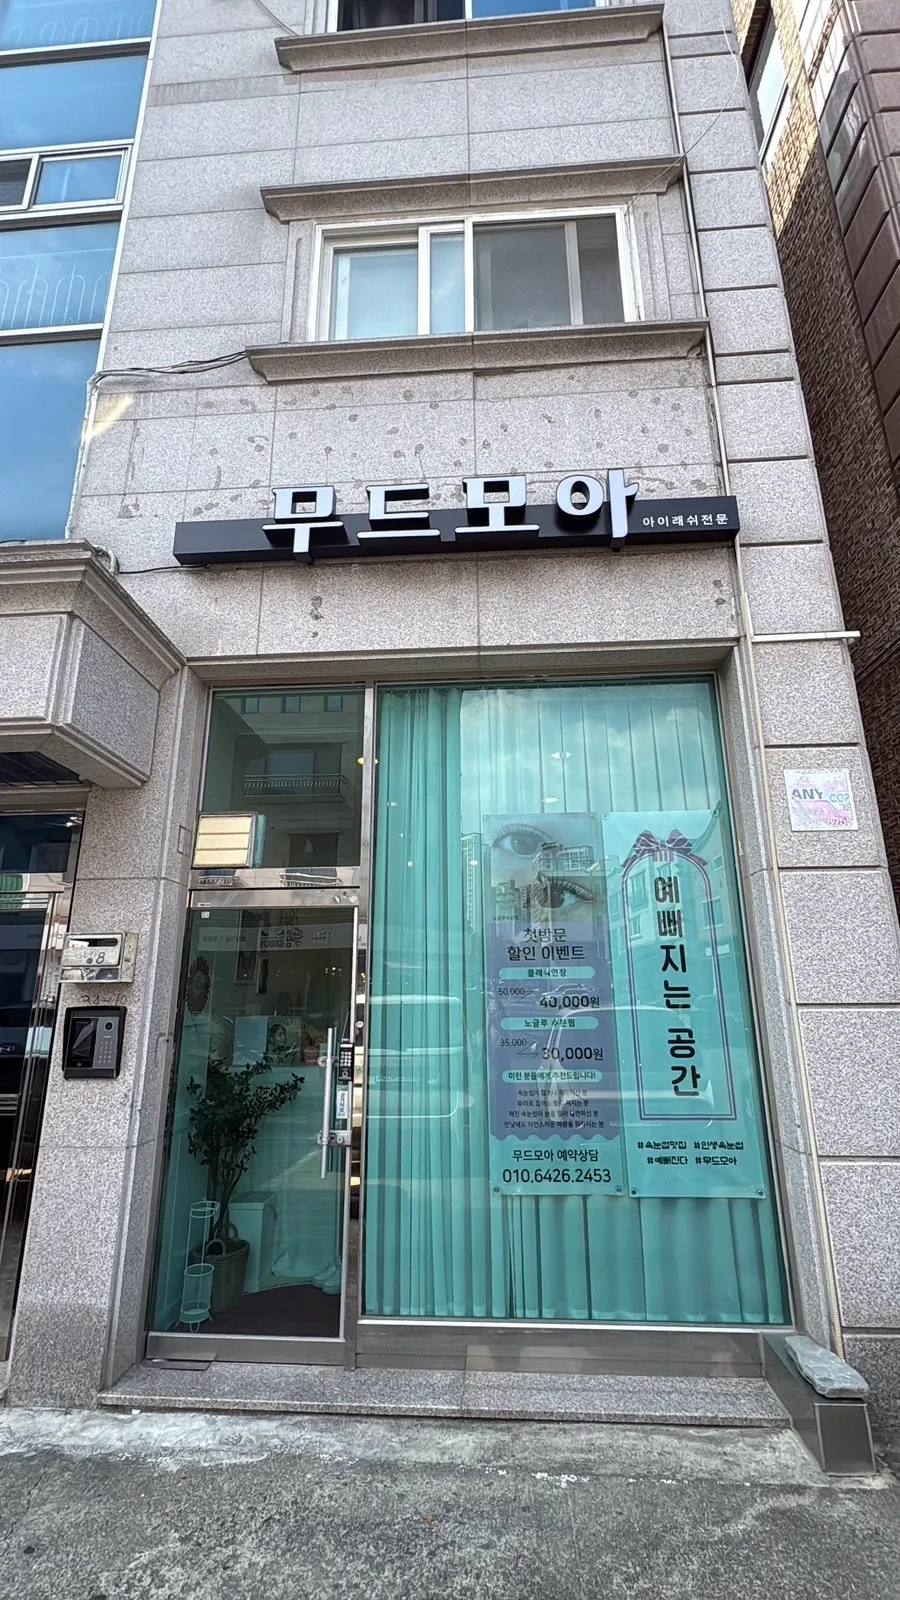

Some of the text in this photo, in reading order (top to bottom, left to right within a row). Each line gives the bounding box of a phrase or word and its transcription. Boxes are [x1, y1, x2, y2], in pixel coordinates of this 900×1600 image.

[262, 468, 638, 553] 무드모아
[642, 513, 729, 528] 아이래쉬전문
[792, 788, 823, 800] ANY
[523, 927, 567, 943] 첫방문
[507, 945, 586, 961] 할인 이벤트
[527, 968, 567, 978] 클래식연장
[653, 875, 702, 1097] 예뻐지는 공간
[540, 995, 600, 1009] 40,000원
[524, 1019, 548, 1028] 노글루
[499, 1038, 528, 1048] 35,000
[542, 1047, 604, 1061] 30,000원
[508, 1071, 522, 1081] 이런
[637, 1140, 744, 1150] #속눈썹맛집 #인생속눈썹
[512, 1149, 599, 1162] 무드모아 예약상담
[695, 1156, 738, 1166] #무드모아
[502, 1168, 611, 1184] 010.6426.2453
